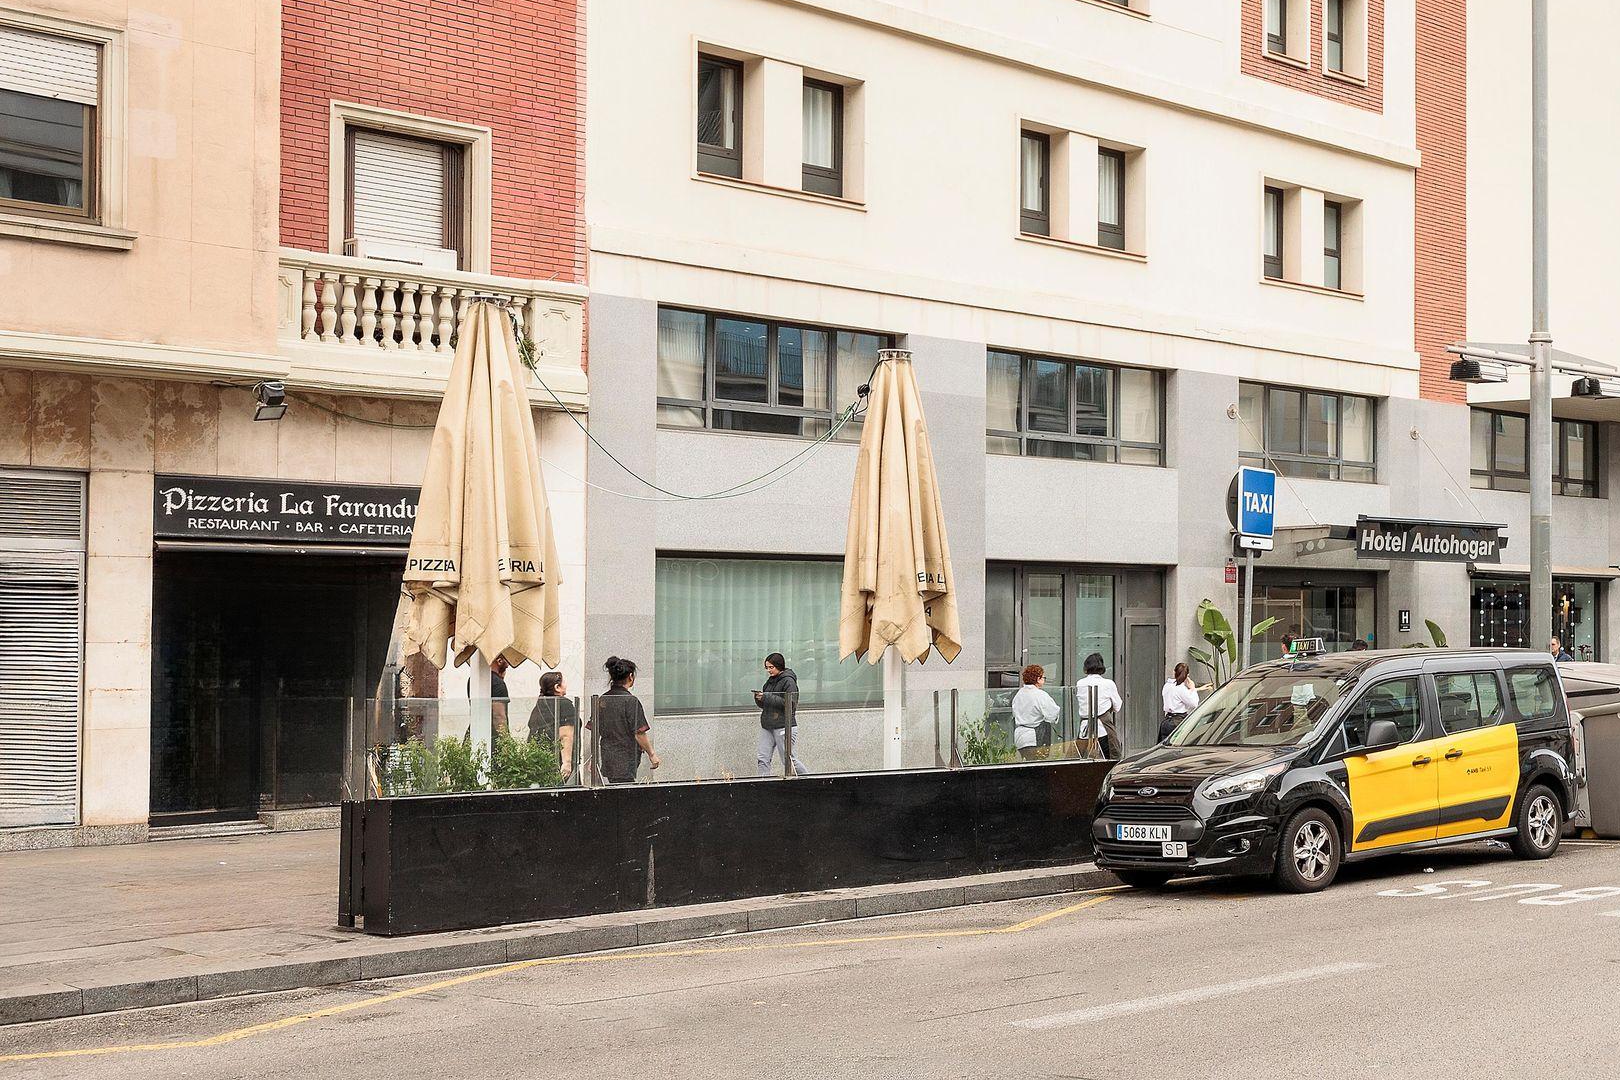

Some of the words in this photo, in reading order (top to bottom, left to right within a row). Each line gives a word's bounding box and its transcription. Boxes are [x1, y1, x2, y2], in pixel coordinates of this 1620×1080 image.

[159, 487, 269, 515] Pizzeria
[280, 493, 314, 515] La
[1243, 491, 1273, 514] TAXI
[188, 518, 280, 532] RESTAURANT
[296, 521, 323, 533] BAR
[338, 523, 414, 536] CAFETERIA
[1361, 529, 1407, 553] Hotel
[1411, 532, 1495, 560] Autohogar
[1401, 611, 1409, 624] H
[1296, 641, 1309, 651] TAXI
[1123, 826, 1146, 839] 5068
[1149, 827, 1168, 840] KLN
[1165, 843, 1184, 856] SP
